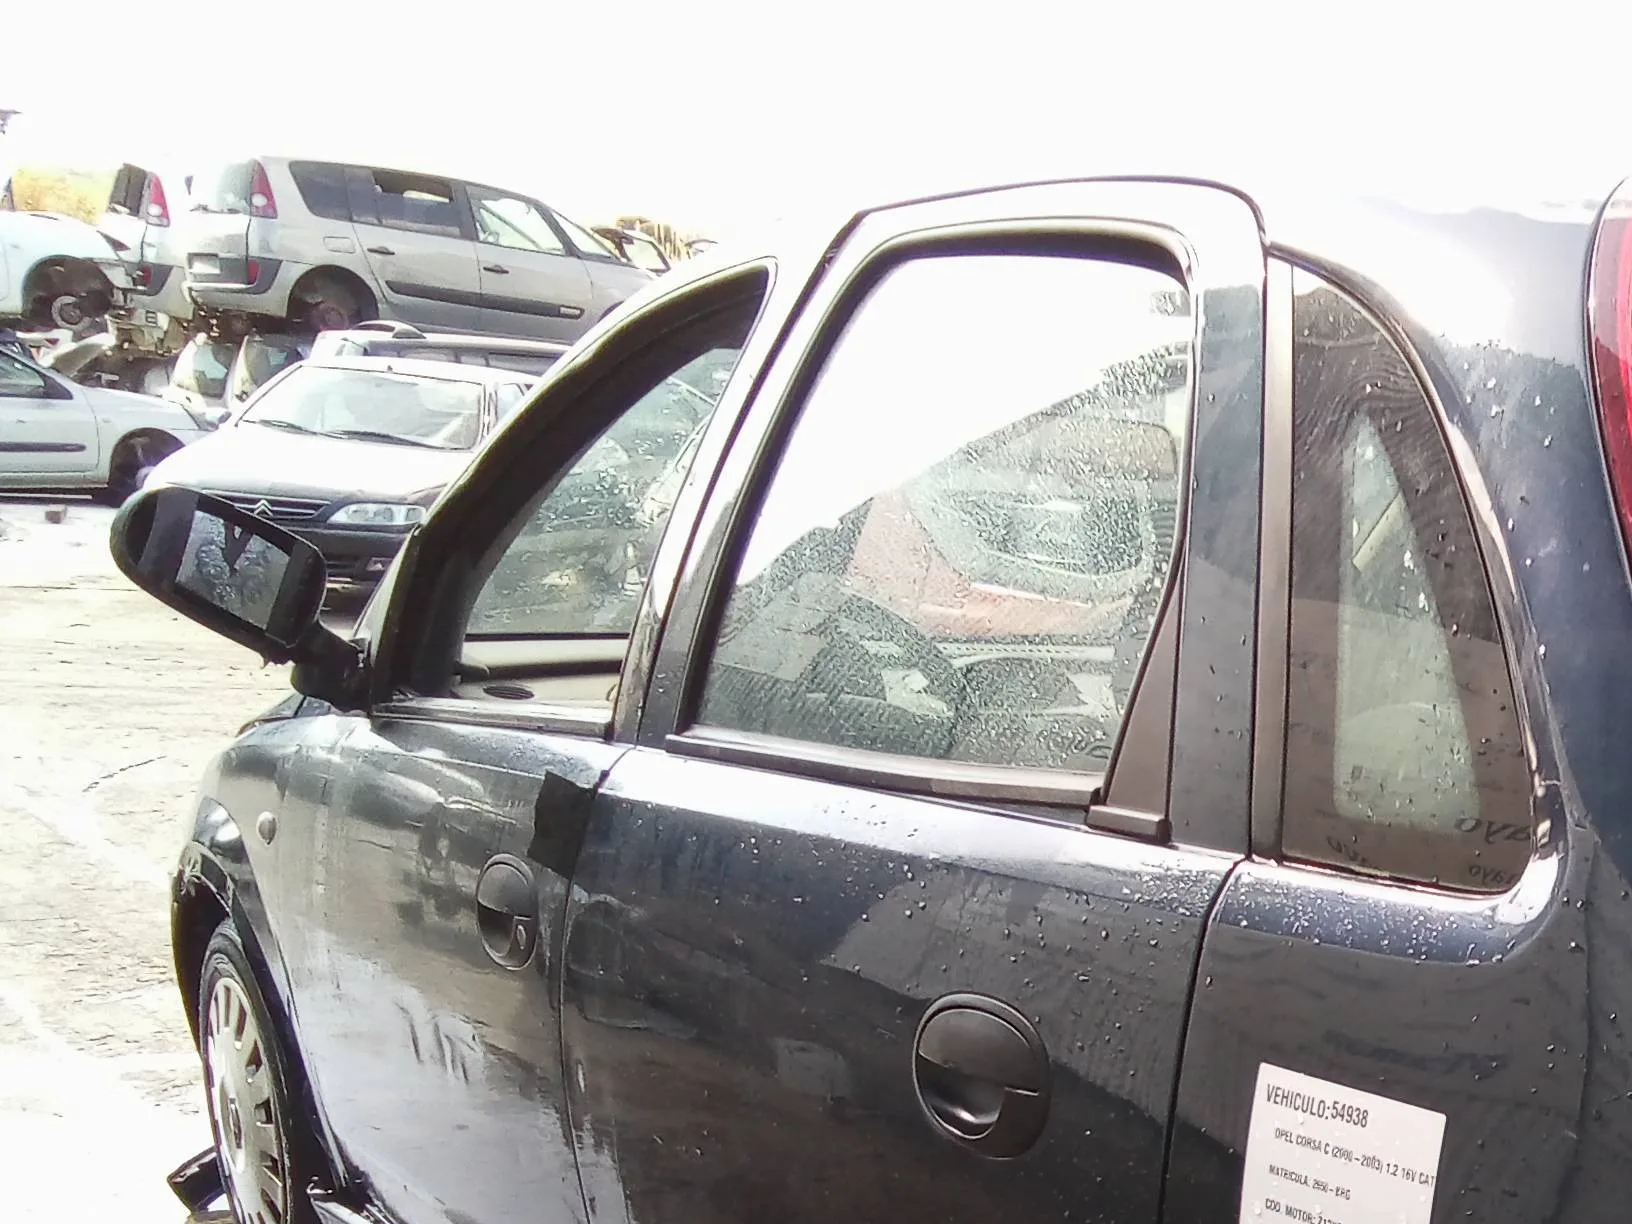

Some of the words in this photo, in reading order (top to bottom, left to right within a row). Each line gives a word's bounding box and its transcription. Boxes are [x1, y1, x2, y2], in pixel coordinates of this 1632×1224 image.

[1266, 1083, 1369, 1128] VEHICULO:54938
[1275, 1128, 1294, 1144] OPEL
[1296, 1134, 1322, 1152] CORSA
[1323, 1142, 1330, 1155] C
[1386, 1163, 1398, 1176] 1.2
[1402, 1167, 1416, 1181] 16V
[1419, 1172, 1435, 1187] CAT
[1285, 1204, 1316, 1224] MOTOR:
